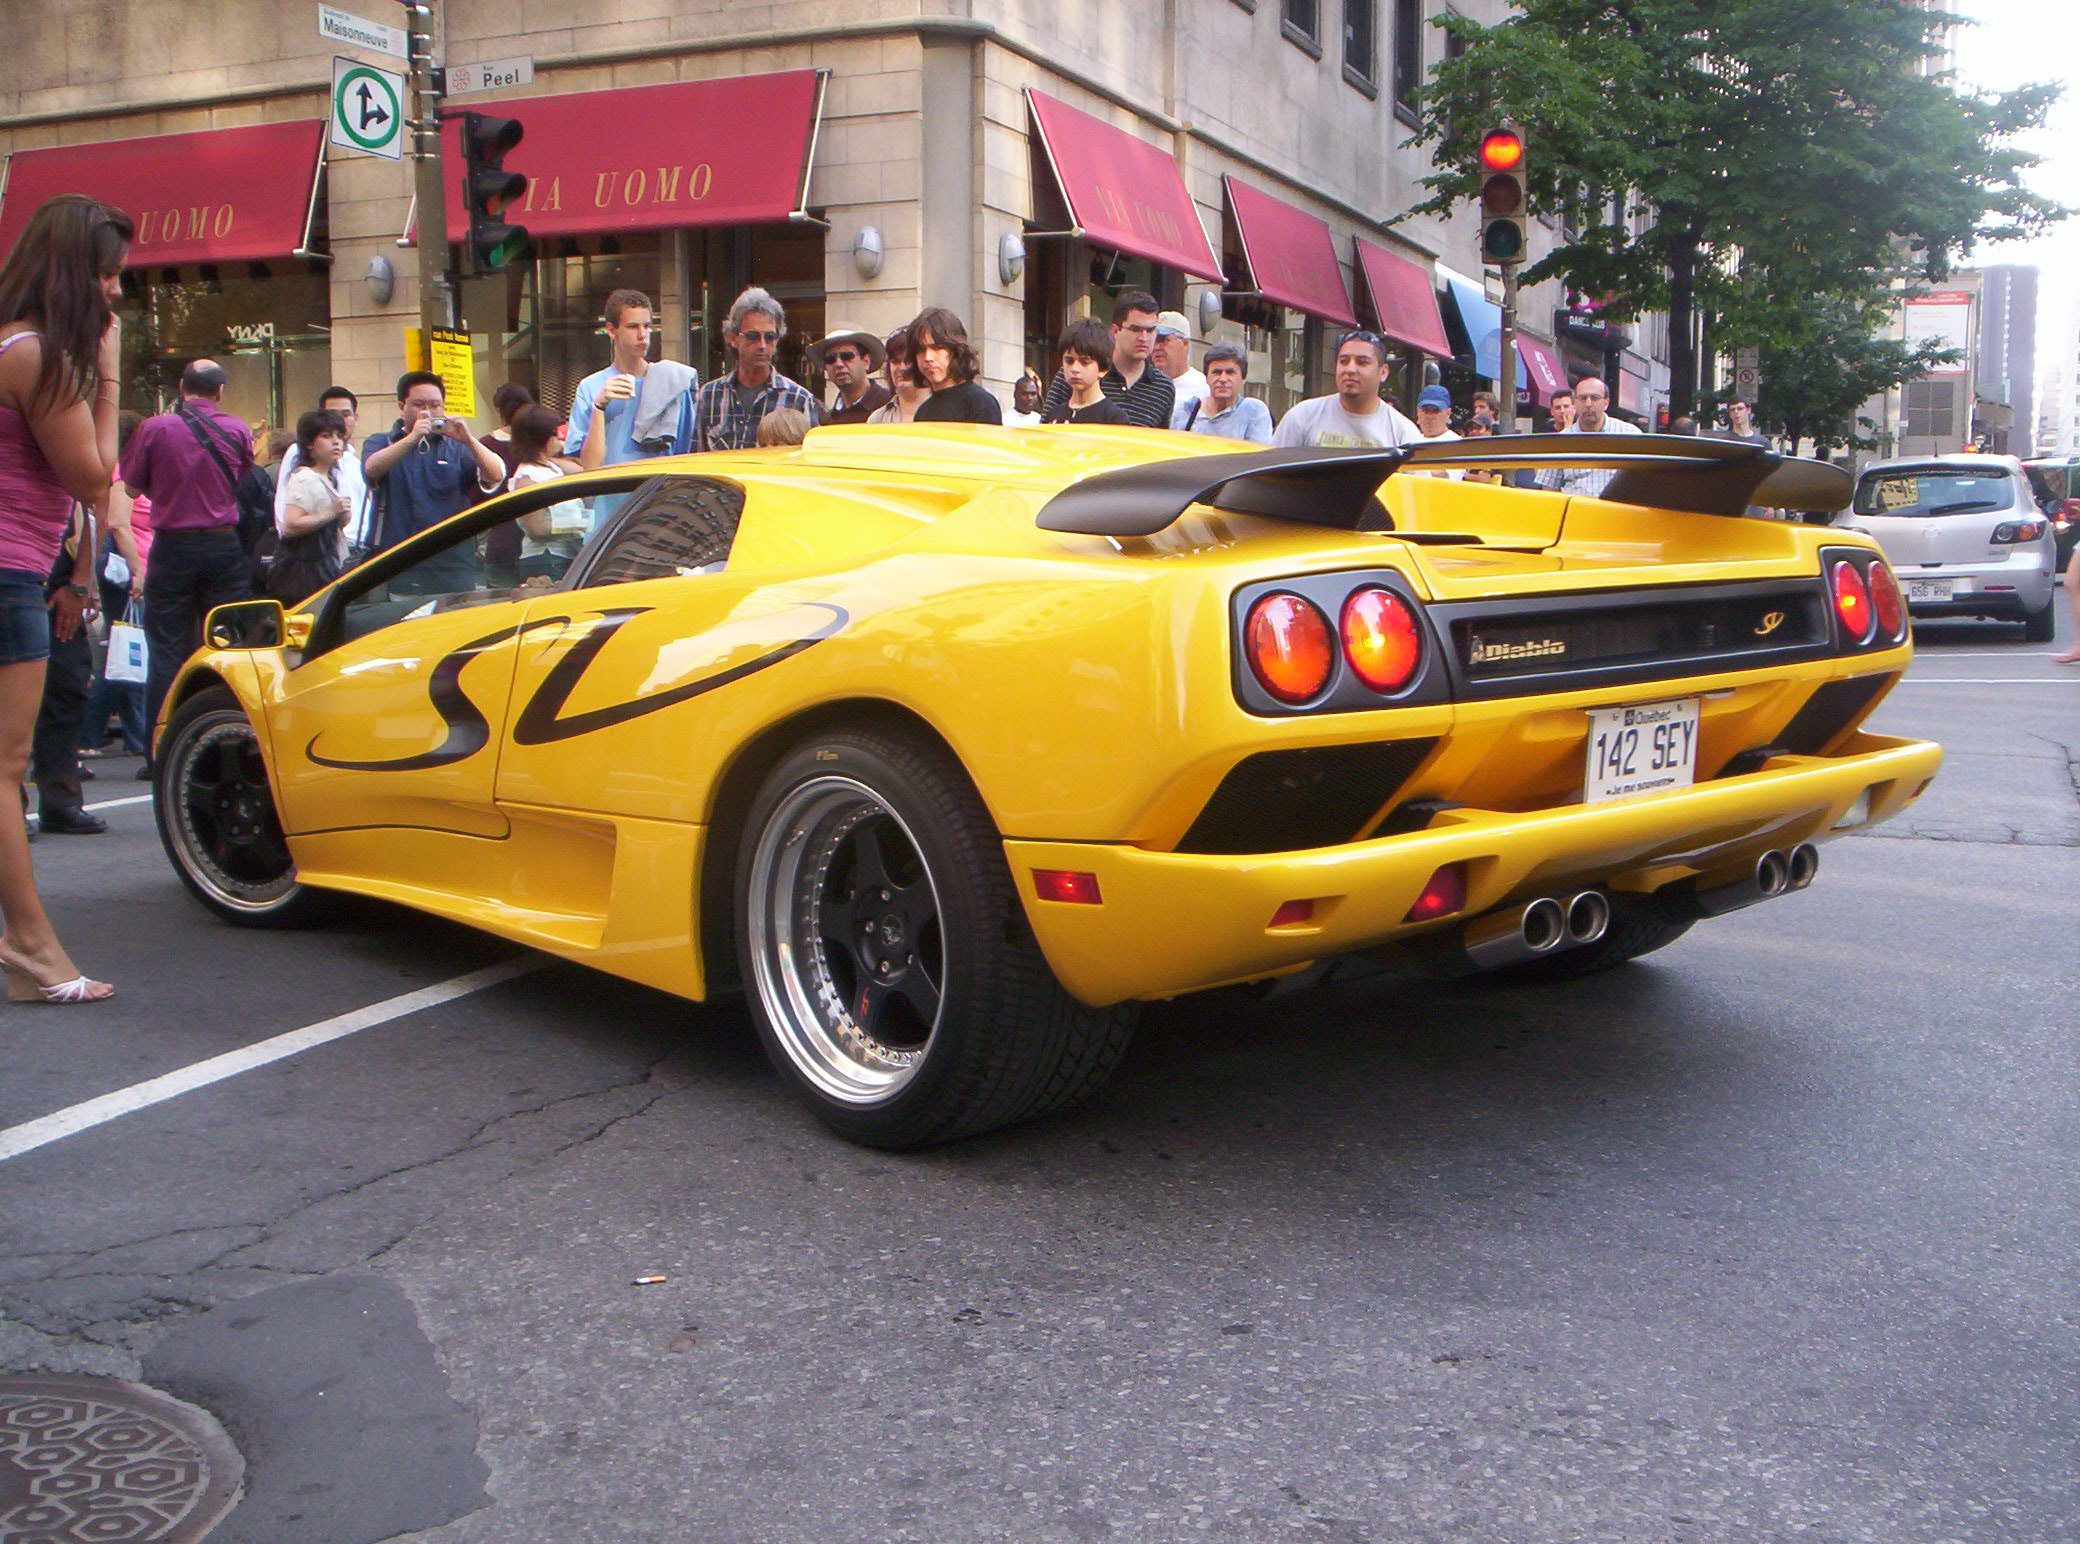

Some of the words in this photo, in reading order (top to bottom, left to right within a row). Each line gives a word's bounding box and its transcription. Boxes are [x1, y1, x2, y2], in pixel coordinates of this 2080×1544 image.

[324, 16, 388, 49] Maisonneuve
[483, 69, 519, 87] Peel
[594, 163, 712, 208] UOMO
[139, 203, 234, 245] UOMO
[1484, 640, 1565, 661] Diablo
[1597, 728, 1638, 780] 142
[1652, 720, 1695, 770] SEY
